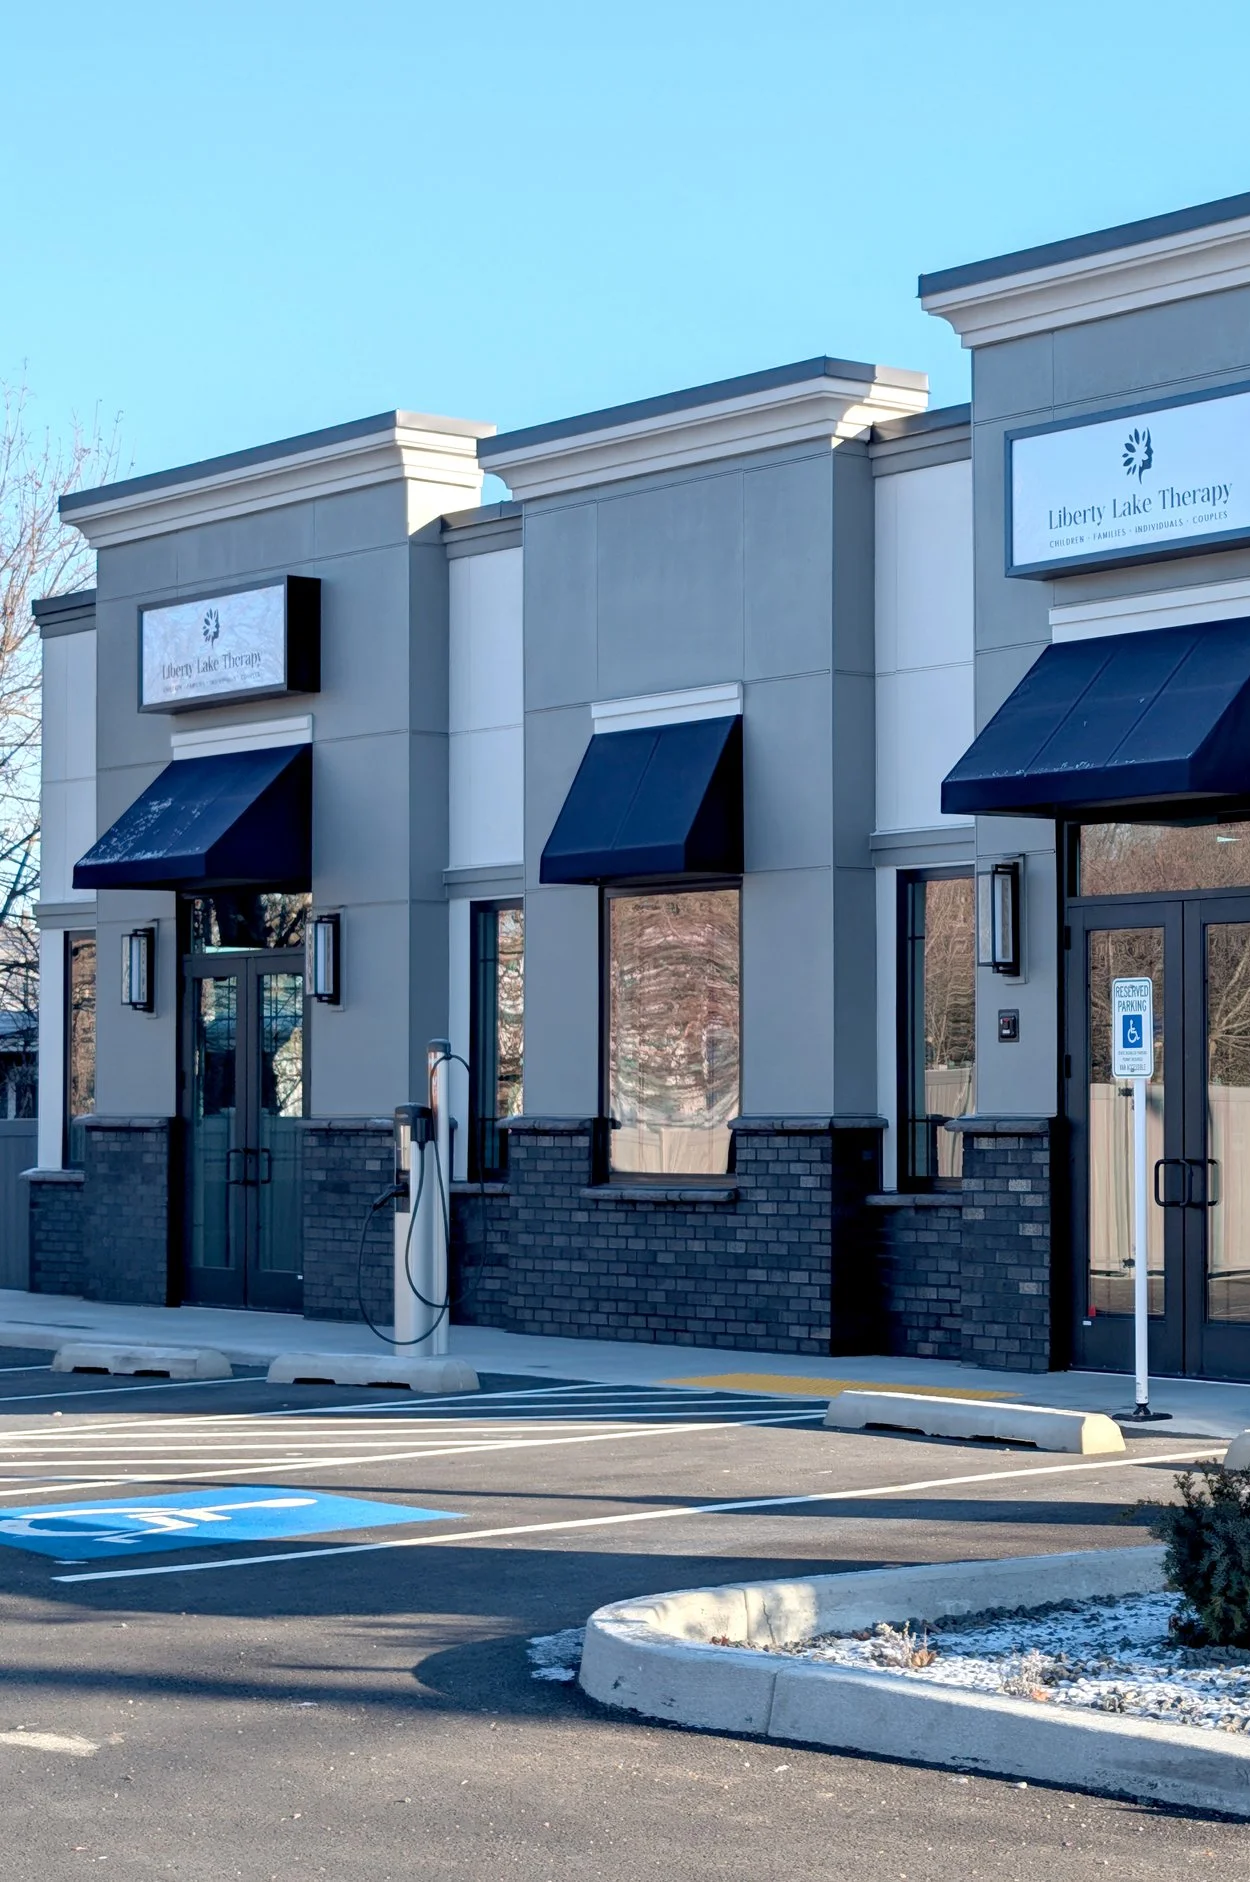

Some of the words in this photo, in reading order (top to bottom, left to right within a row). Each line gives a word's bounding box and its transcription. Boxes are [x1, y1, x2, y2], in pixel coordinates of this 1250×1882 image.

[1048, 506, 1106, 530] Liberty
[1112, 494, 1152, 519] Lake
[1158, 482, 1233, 510] Therapy
[1049, 535, 1084, 548] CHILDREN
[1093, 528, 1127, 541] FAMILIES
[1134, 518, 1183, 533] INDIVIDUALS
[1192, 510, 1228, 524] COUPLES
[197, 656, 219, 674] Lake
[222, 651, 261, 669] Therapy
[1115, 984, 1149, 998] RESERVED
[1117, 1000, 1147, 1012] PARKING
